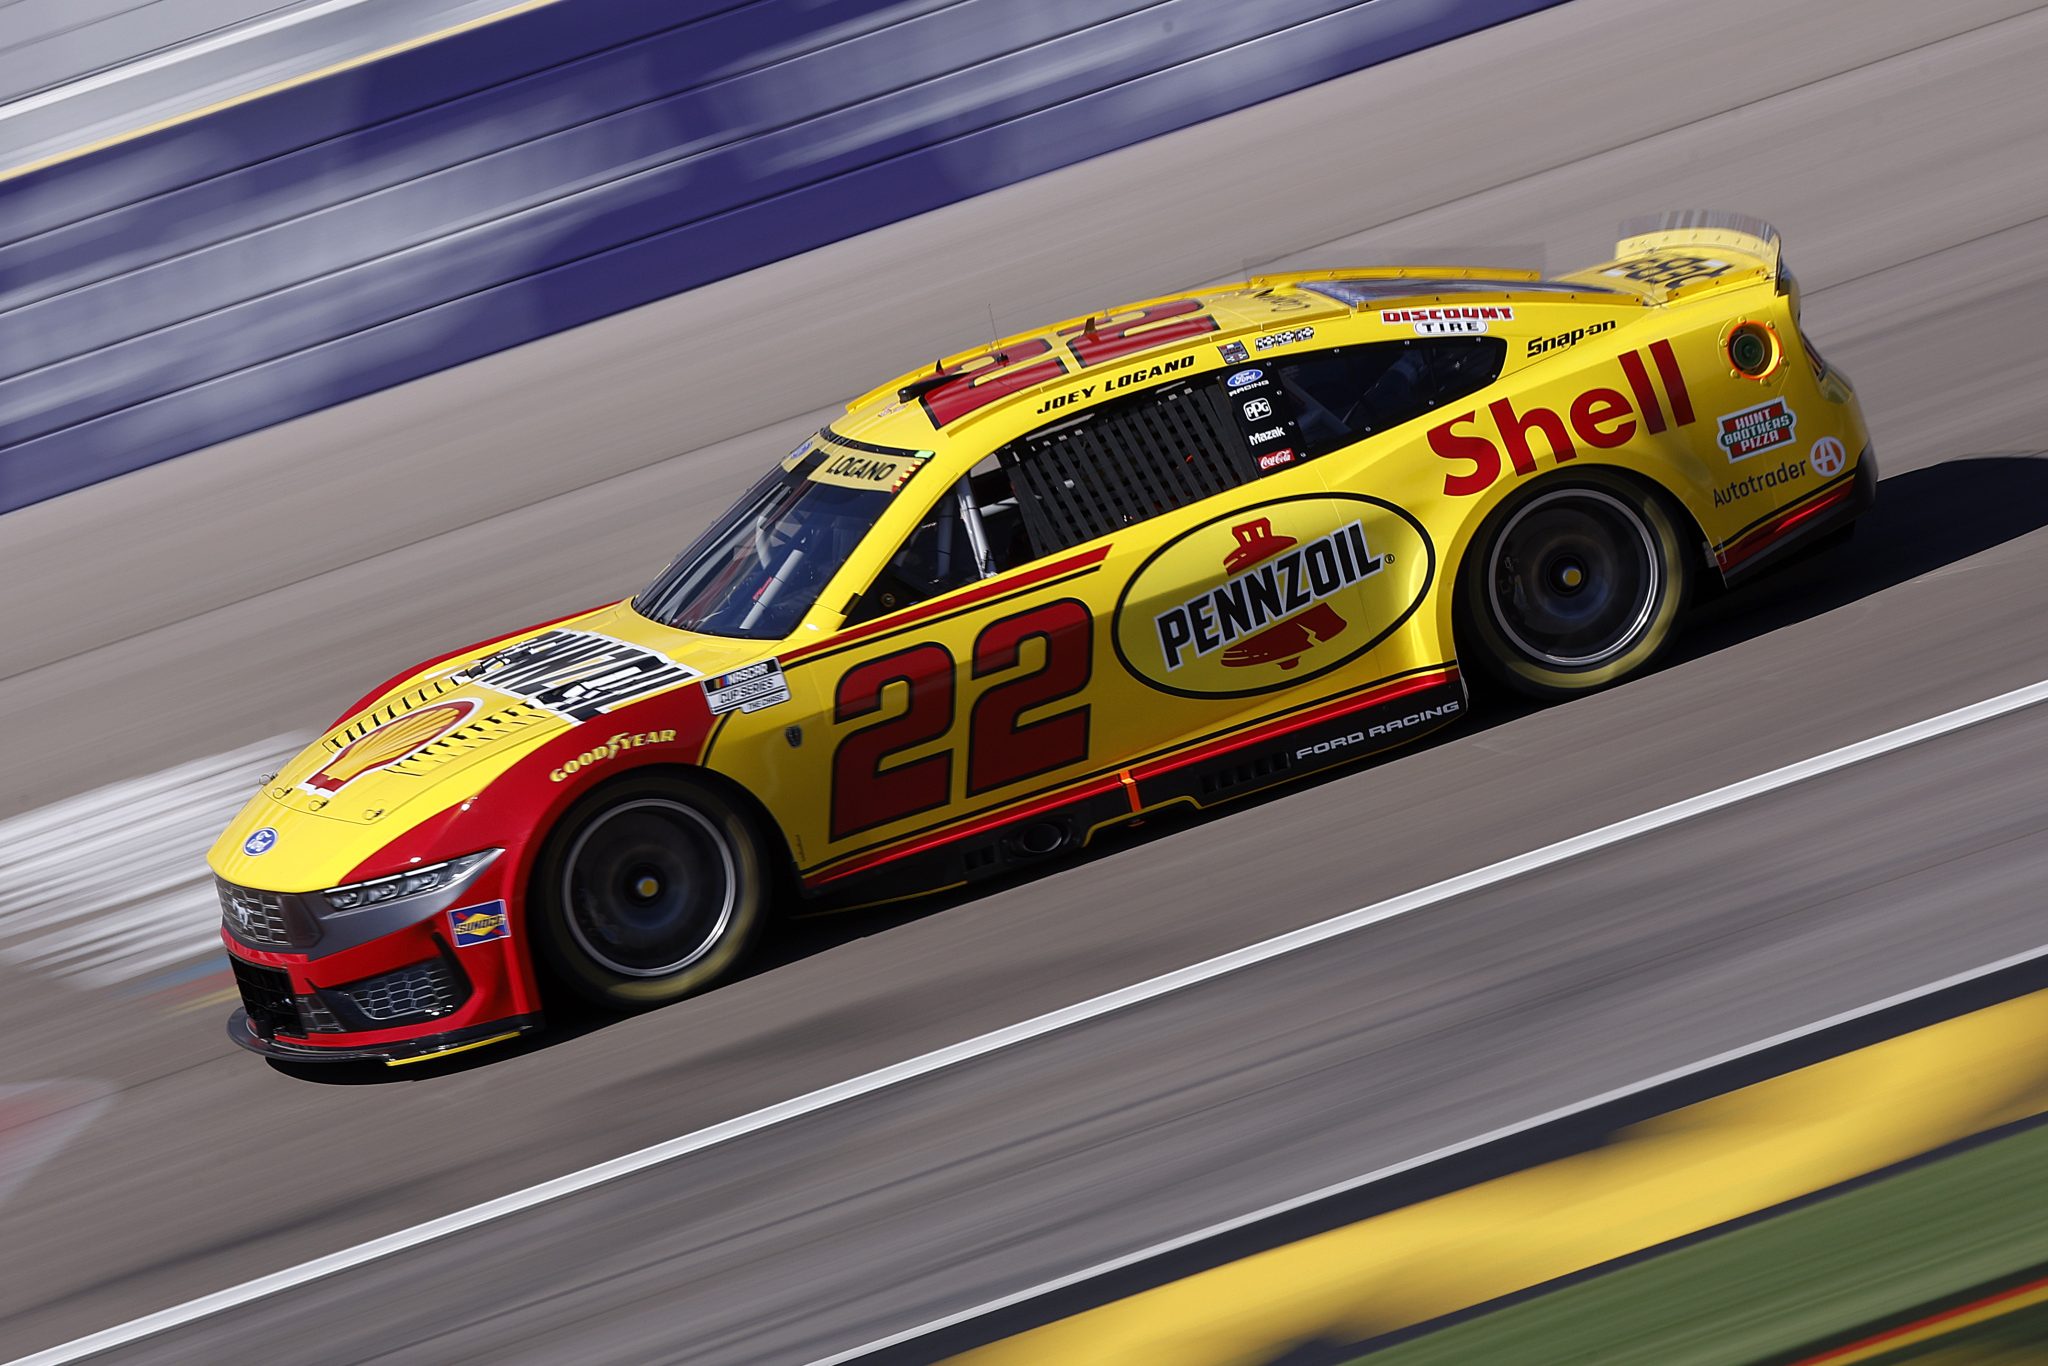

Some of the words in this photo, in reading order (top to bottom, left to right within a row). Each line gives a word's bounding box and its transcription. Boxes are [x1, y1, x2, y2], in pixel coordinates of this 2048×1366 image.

[1382, 307, 1513, 322] DISCOUNT
[1422, 322, 1479, 333] TIRE
[1527, 320, 1616, 358] Snap-on
[1037, 386, 1097, 415] JOEY
[1104, 355, 1195, 392] LOGANO
[1229, 379, 1269, 397] RACING
[1232, 370, 1260, 386] Ford
[1246, 399, 1270, 419] PPG
[1426, 339, 1695, 496] Shell
[1735, 408, 1772, 430] HUNT
[1249, 426, 1285, 446] Mazak
[1724, 415, 1790, 445] BROTHERS
[1741, 430, 1779, 452] PIZZA
[826, 455, 896, 481] LOGANO
[1713, 460, 1806, 508] Autotrader
[1154, 520, 1384, 671] PENNZOIL
[728, 663, 769, 684] NASCAR
[720, 689, 739, 704] CUP
[740, 678, 774, 697] SERIES
[828, 597, 1094, 844] 22
[1296, 732, 1365, 760] FORD
[1368, 701, 1460, 738] RACING
[549, 729, 677, 782] GOODYEAR
[453, 913, 506, 935] SUNOCO
